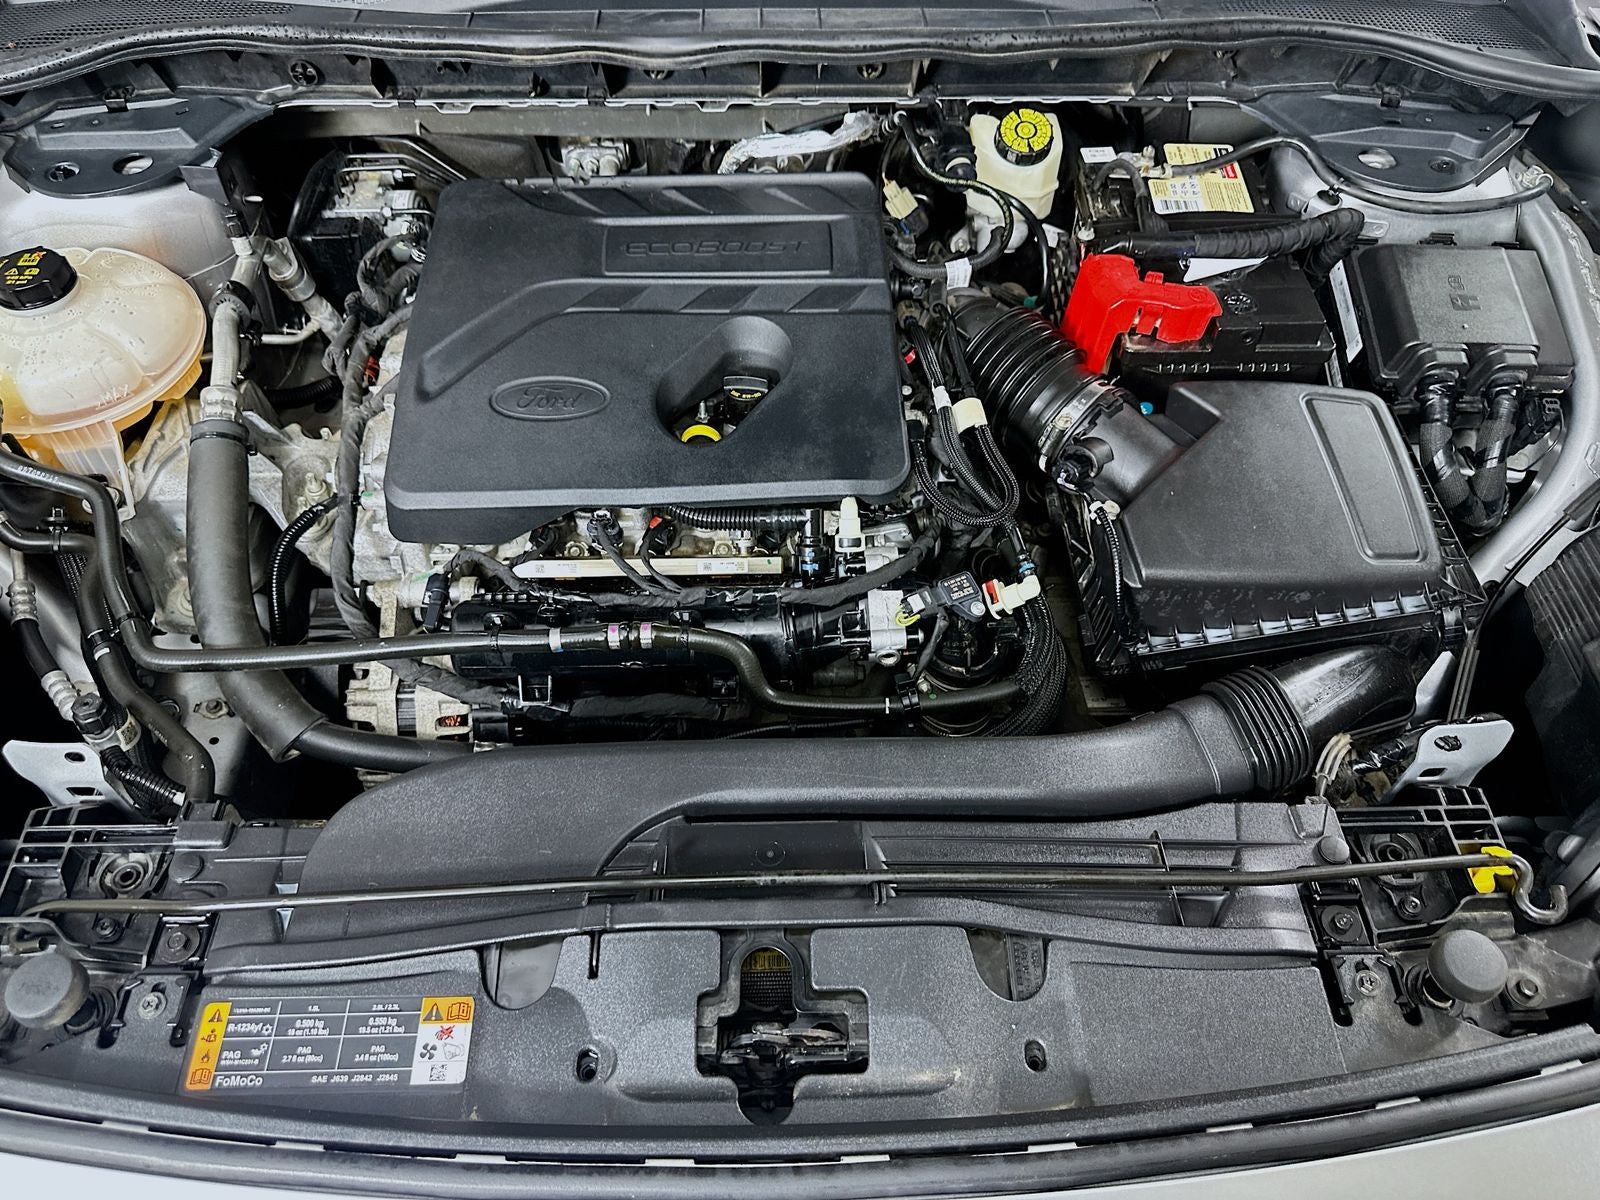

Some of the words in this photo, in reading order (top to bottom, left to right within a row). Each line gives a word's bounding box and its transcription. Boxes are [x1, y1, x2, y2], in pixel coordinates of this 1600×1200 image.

[517, 387, 583, 411] Ford
[295, 1019, 314, 1028] 0.500
[315, 1019, 325, 1029] kg
[368, 1016, 387, 1026] 0.550
[388, 1016, 398, 1027] kg
[228, 1022, 262, 1034] R-1234yf
[371, 1026, 379, 1034] oz
[297, 1046, 312, 1054] PAG
[371, 1045, 386, 1053] PAG
[222, 1051, 241, 1059] PAG
[215, 1075, 263, 1088] FoMoCo
[311, 1075, 328, 1083] SAE
[331, 1075, 349, 1083] J639
[352, 1074, 373, 1082] J2842
[377, 1073, 399, 1081] J2845
